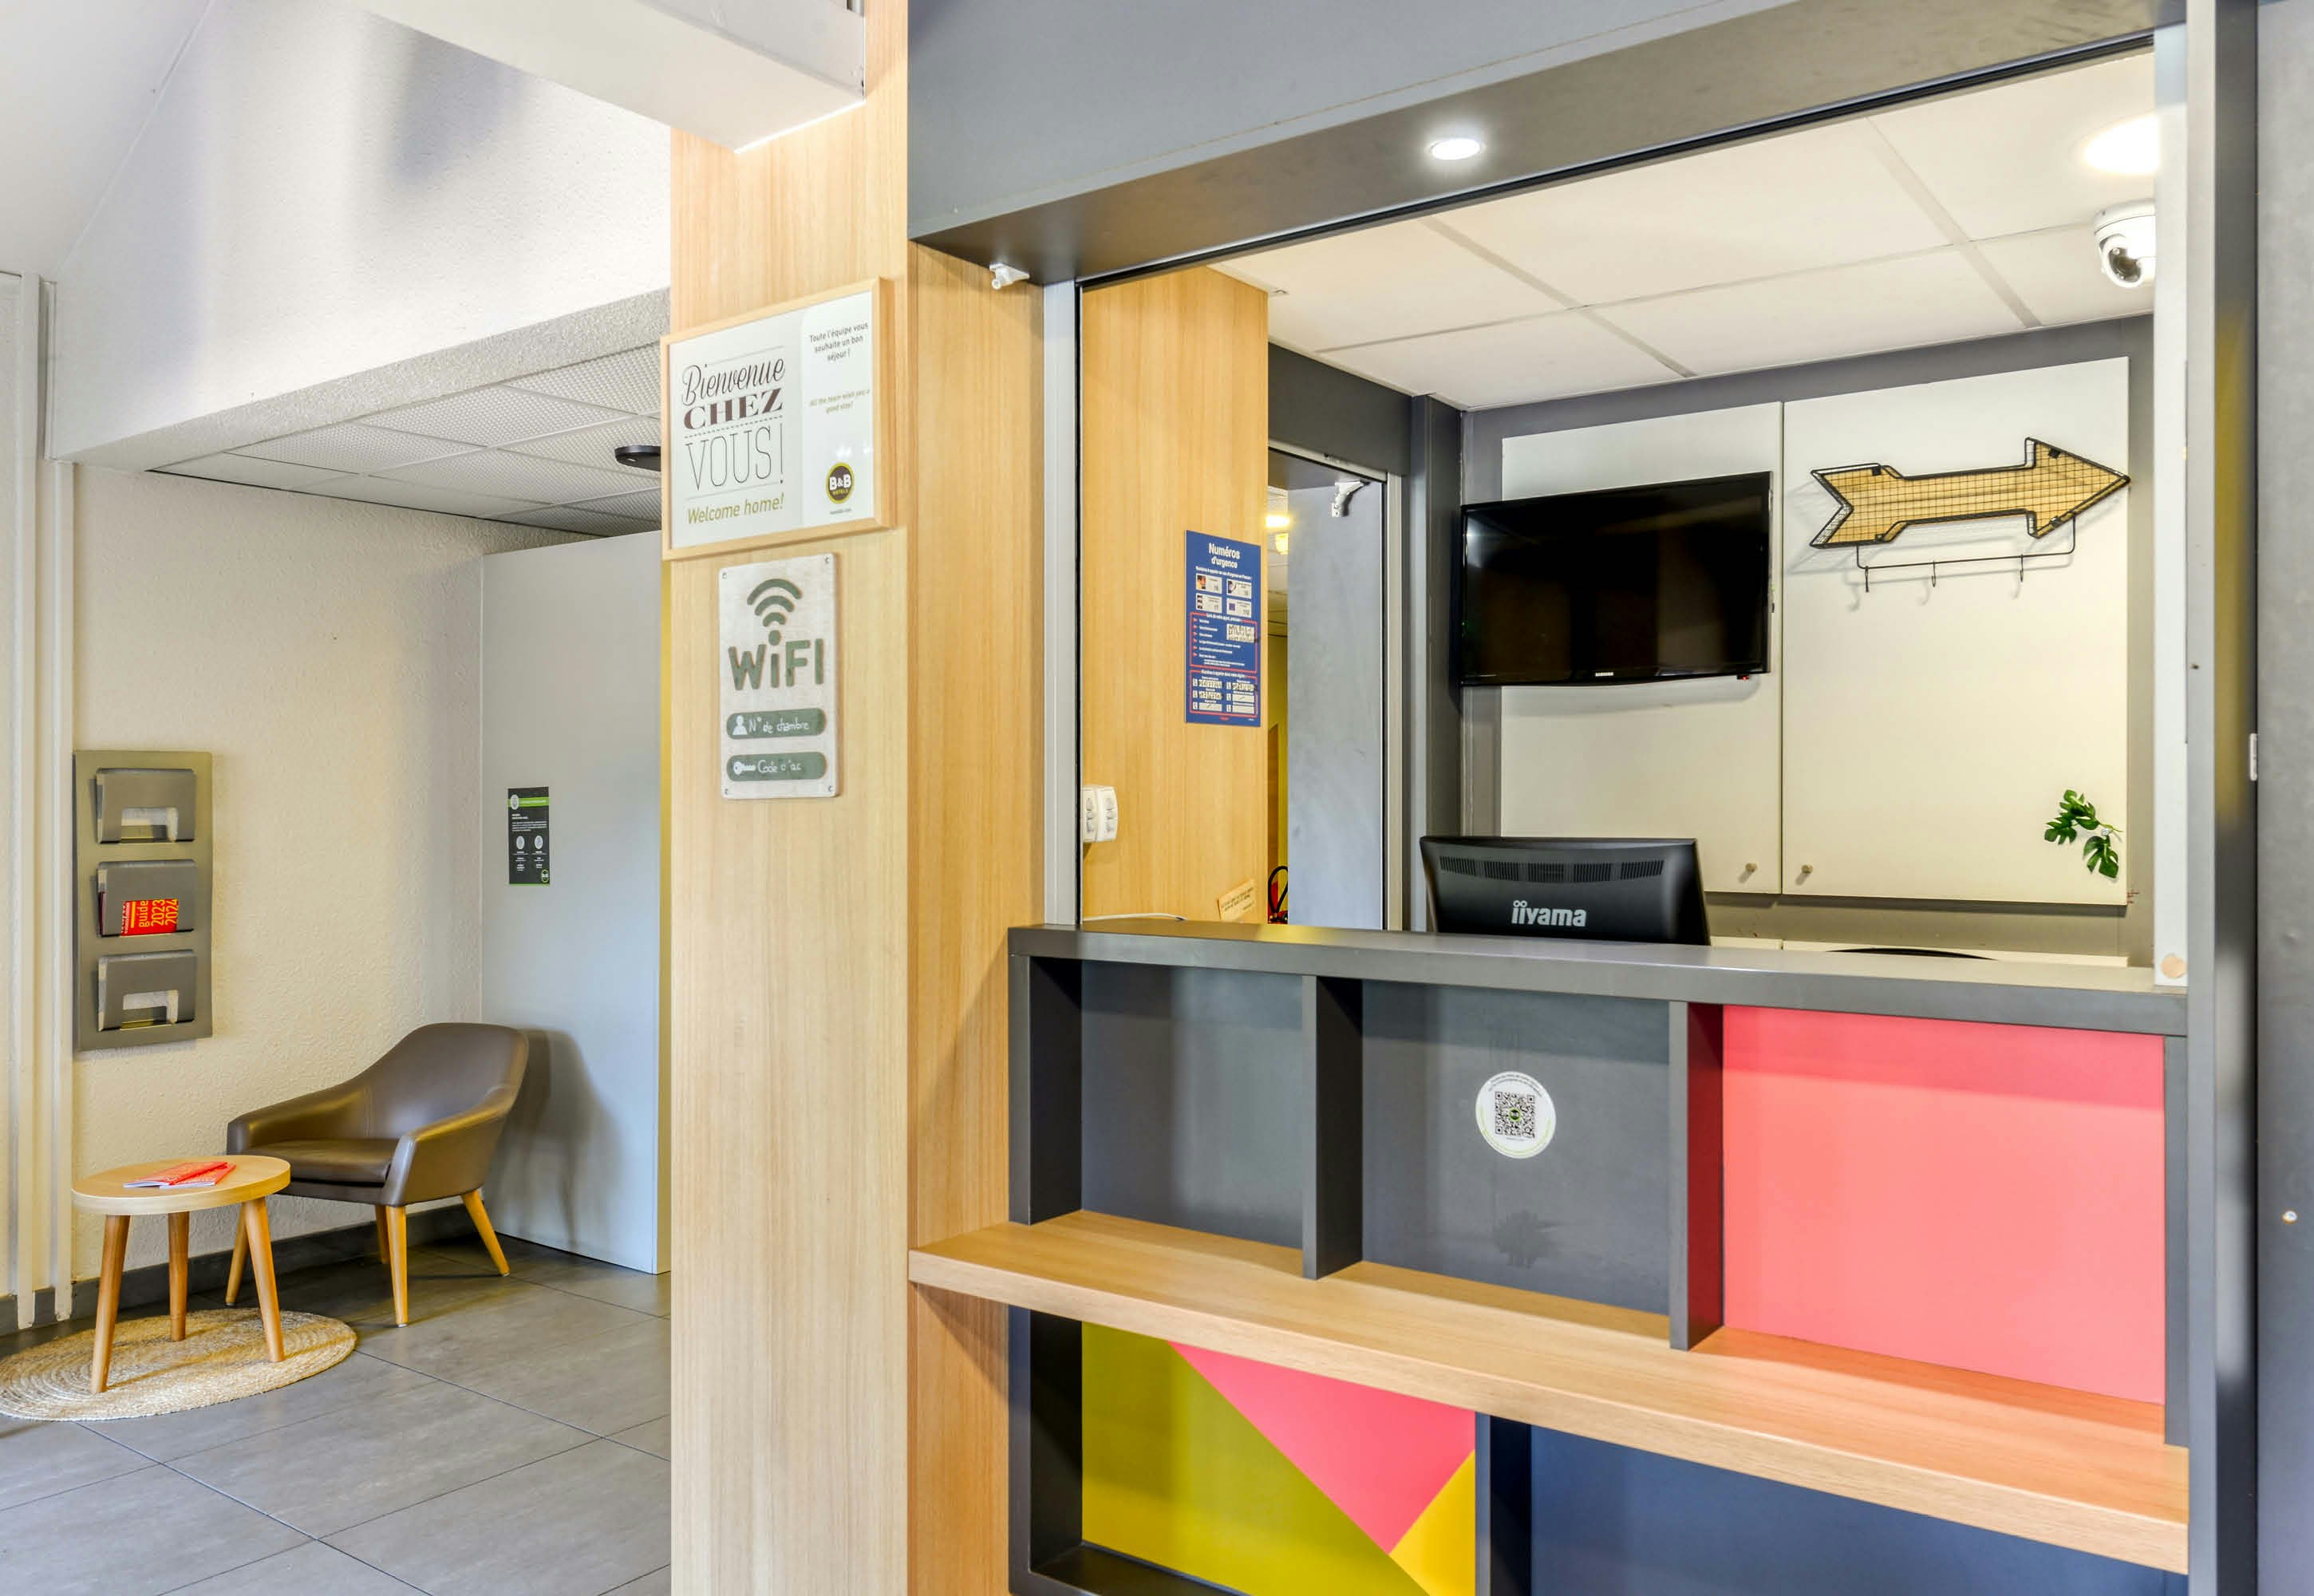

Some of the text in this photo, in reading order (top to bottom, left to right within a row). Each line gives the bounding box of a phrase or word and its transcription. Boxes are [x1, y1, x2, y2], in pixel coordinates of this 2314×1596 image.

[810, 333, 827, 343] Toute
[854, 322, 868, 332] vous
[815, 341, 841, 353] souhaite
[851, 335, 863, 344] bon
[682, 358, 785, 406] Bienvenue
[684, 388, 783, 430] CHEZ
[830, 474, 851, 491] B&B
[687, 504, 740, 524] Welcome
[744, 492, 784, 516] home!
[1208, 542, 1241, 559] Numéros
[1211, 555, 1238, 569] d'urgence
[136, 900, 150, 927] guide
[151, 899, 166, 926] 2023
[1511, 900, 1586, 927] iiyama
